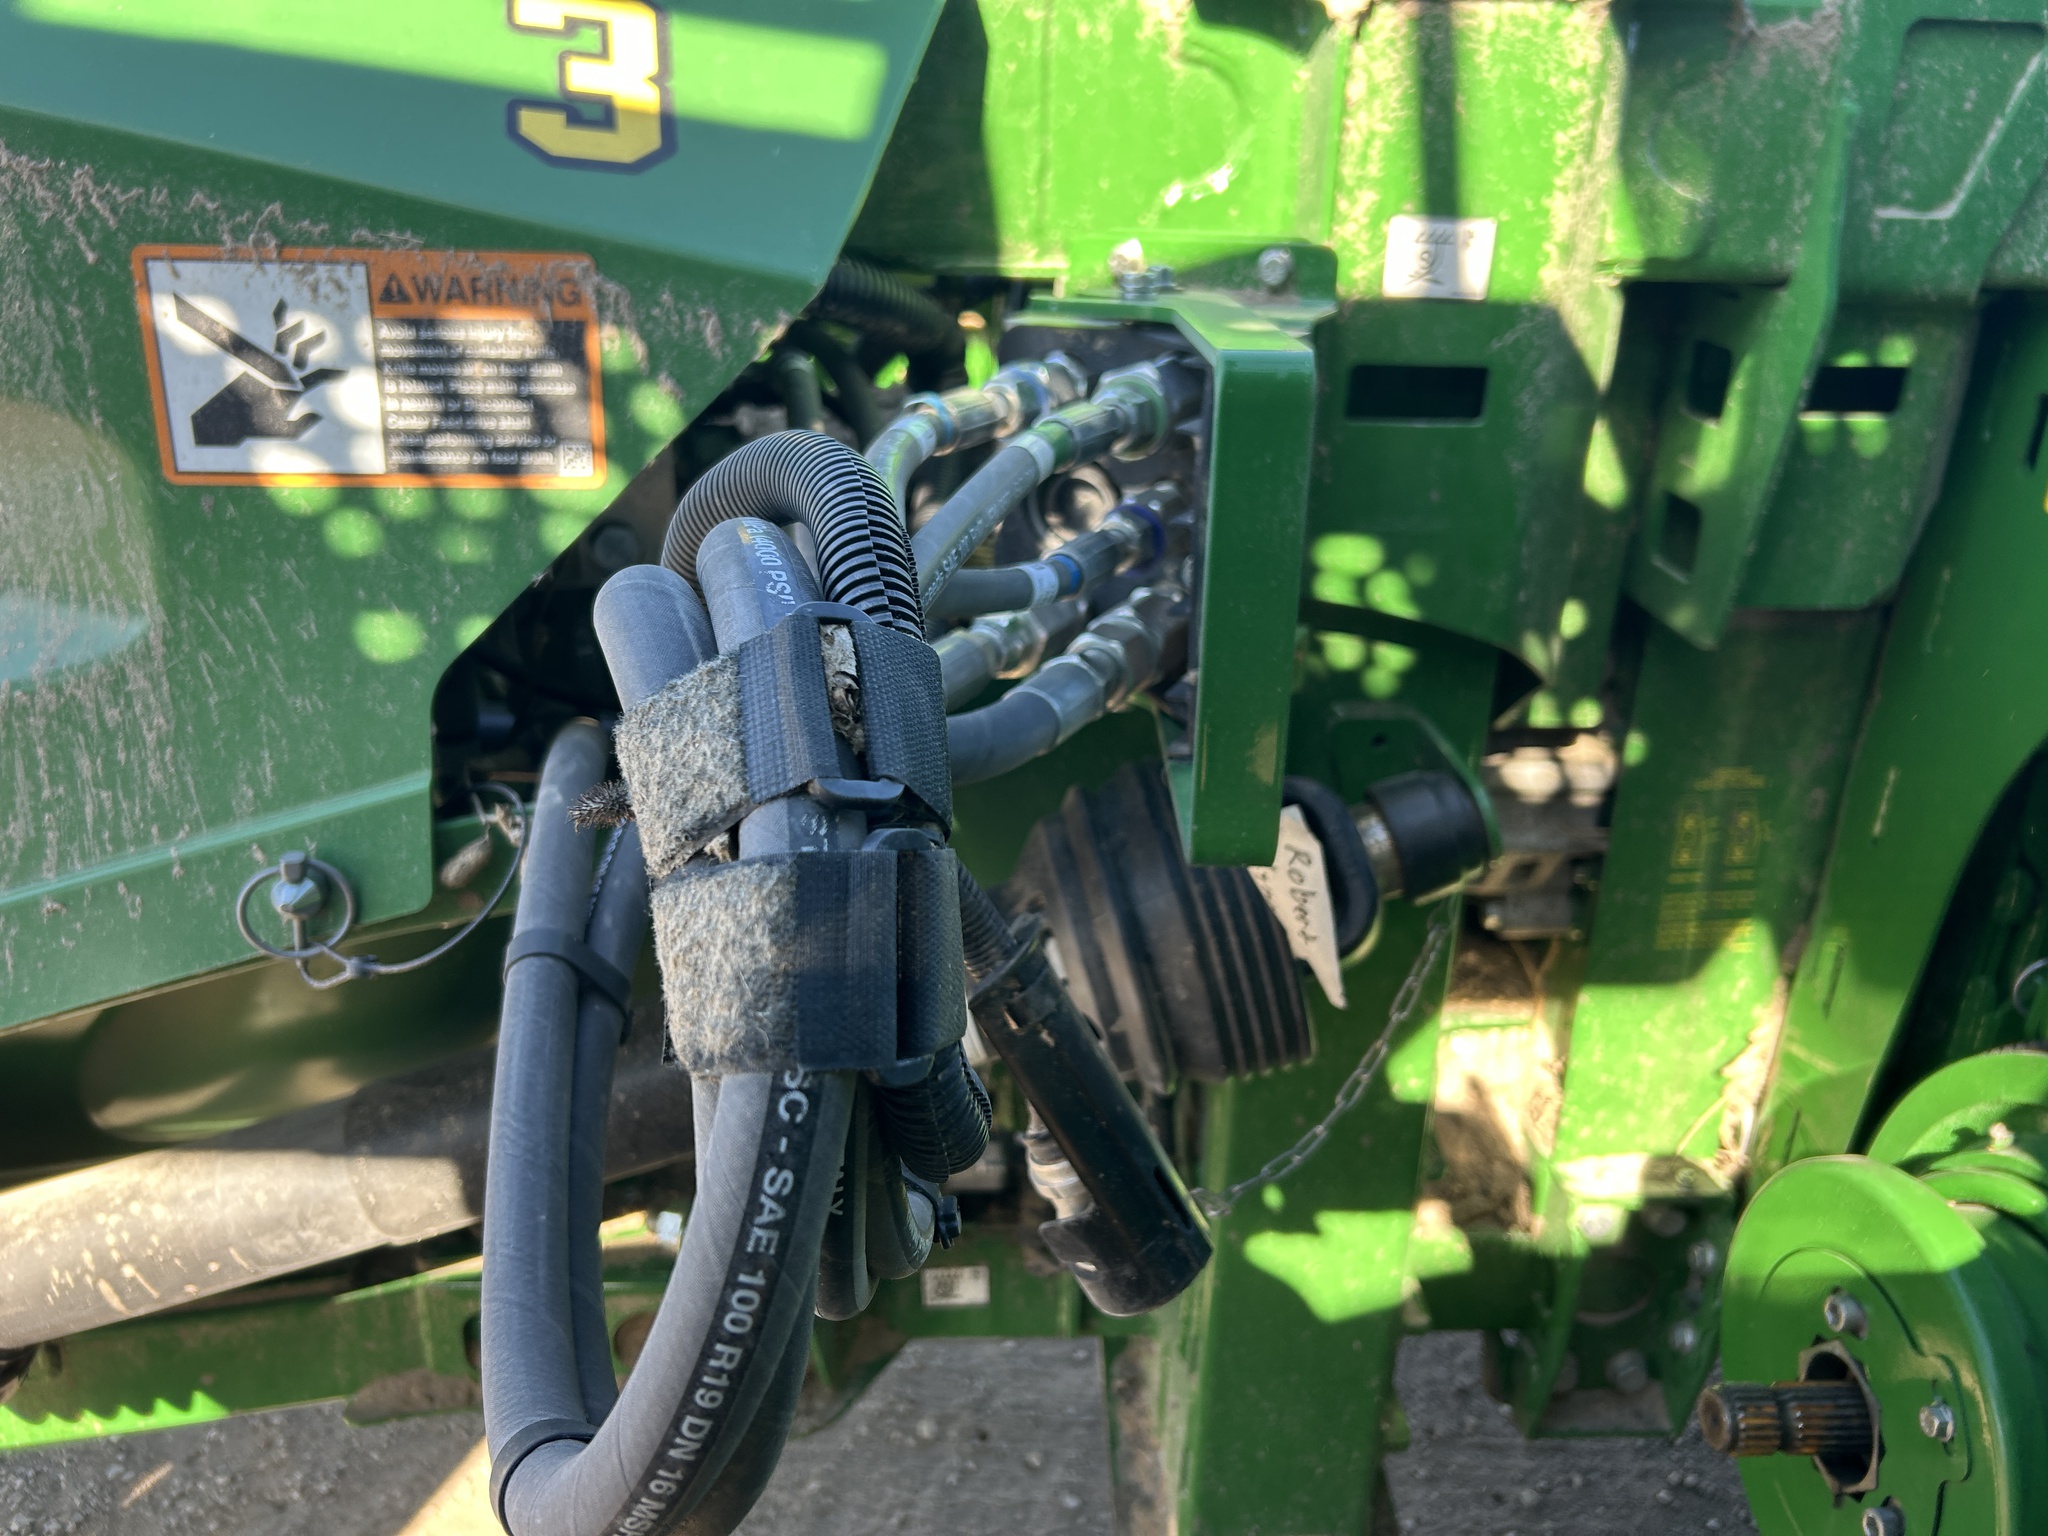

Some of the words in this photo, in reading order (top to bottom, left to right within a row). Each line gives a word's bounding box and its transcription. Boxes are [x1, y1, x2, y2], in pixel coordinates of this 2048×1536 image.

[507, 0, 677, 176] 3
[1284, 843, 1319, 945] Robert
[746, 1166, 795, 1256] SAE
[722, 1269, 768, 1335] 100
[693, 1342, 745, 1410] R19
[667, 1415, 715, 1462] DN
[647, 1468, 685, 1497] 16
